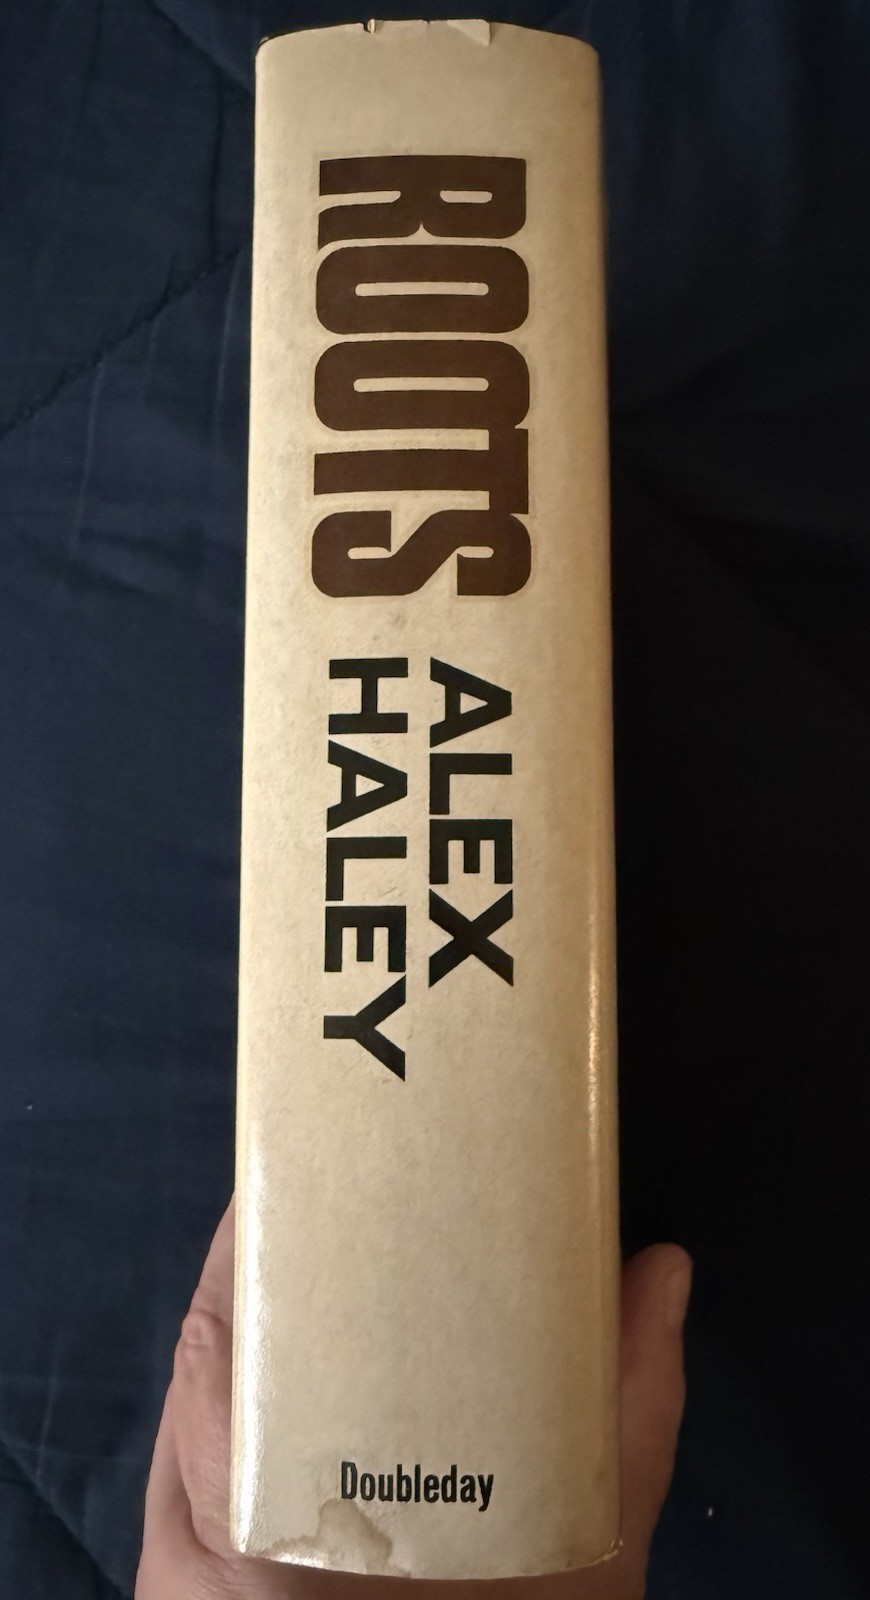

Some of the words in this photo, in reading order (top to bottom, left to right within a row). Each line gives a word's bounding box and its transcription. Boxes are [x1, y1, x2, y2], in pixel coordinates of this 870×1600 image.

[312, 155, 532, 598] ROOTS
[323, 657, 408, 1081] HALEY
[428, 657, 514, 987] ALEX
[341, 1461, 494, 1512] Doubleday
